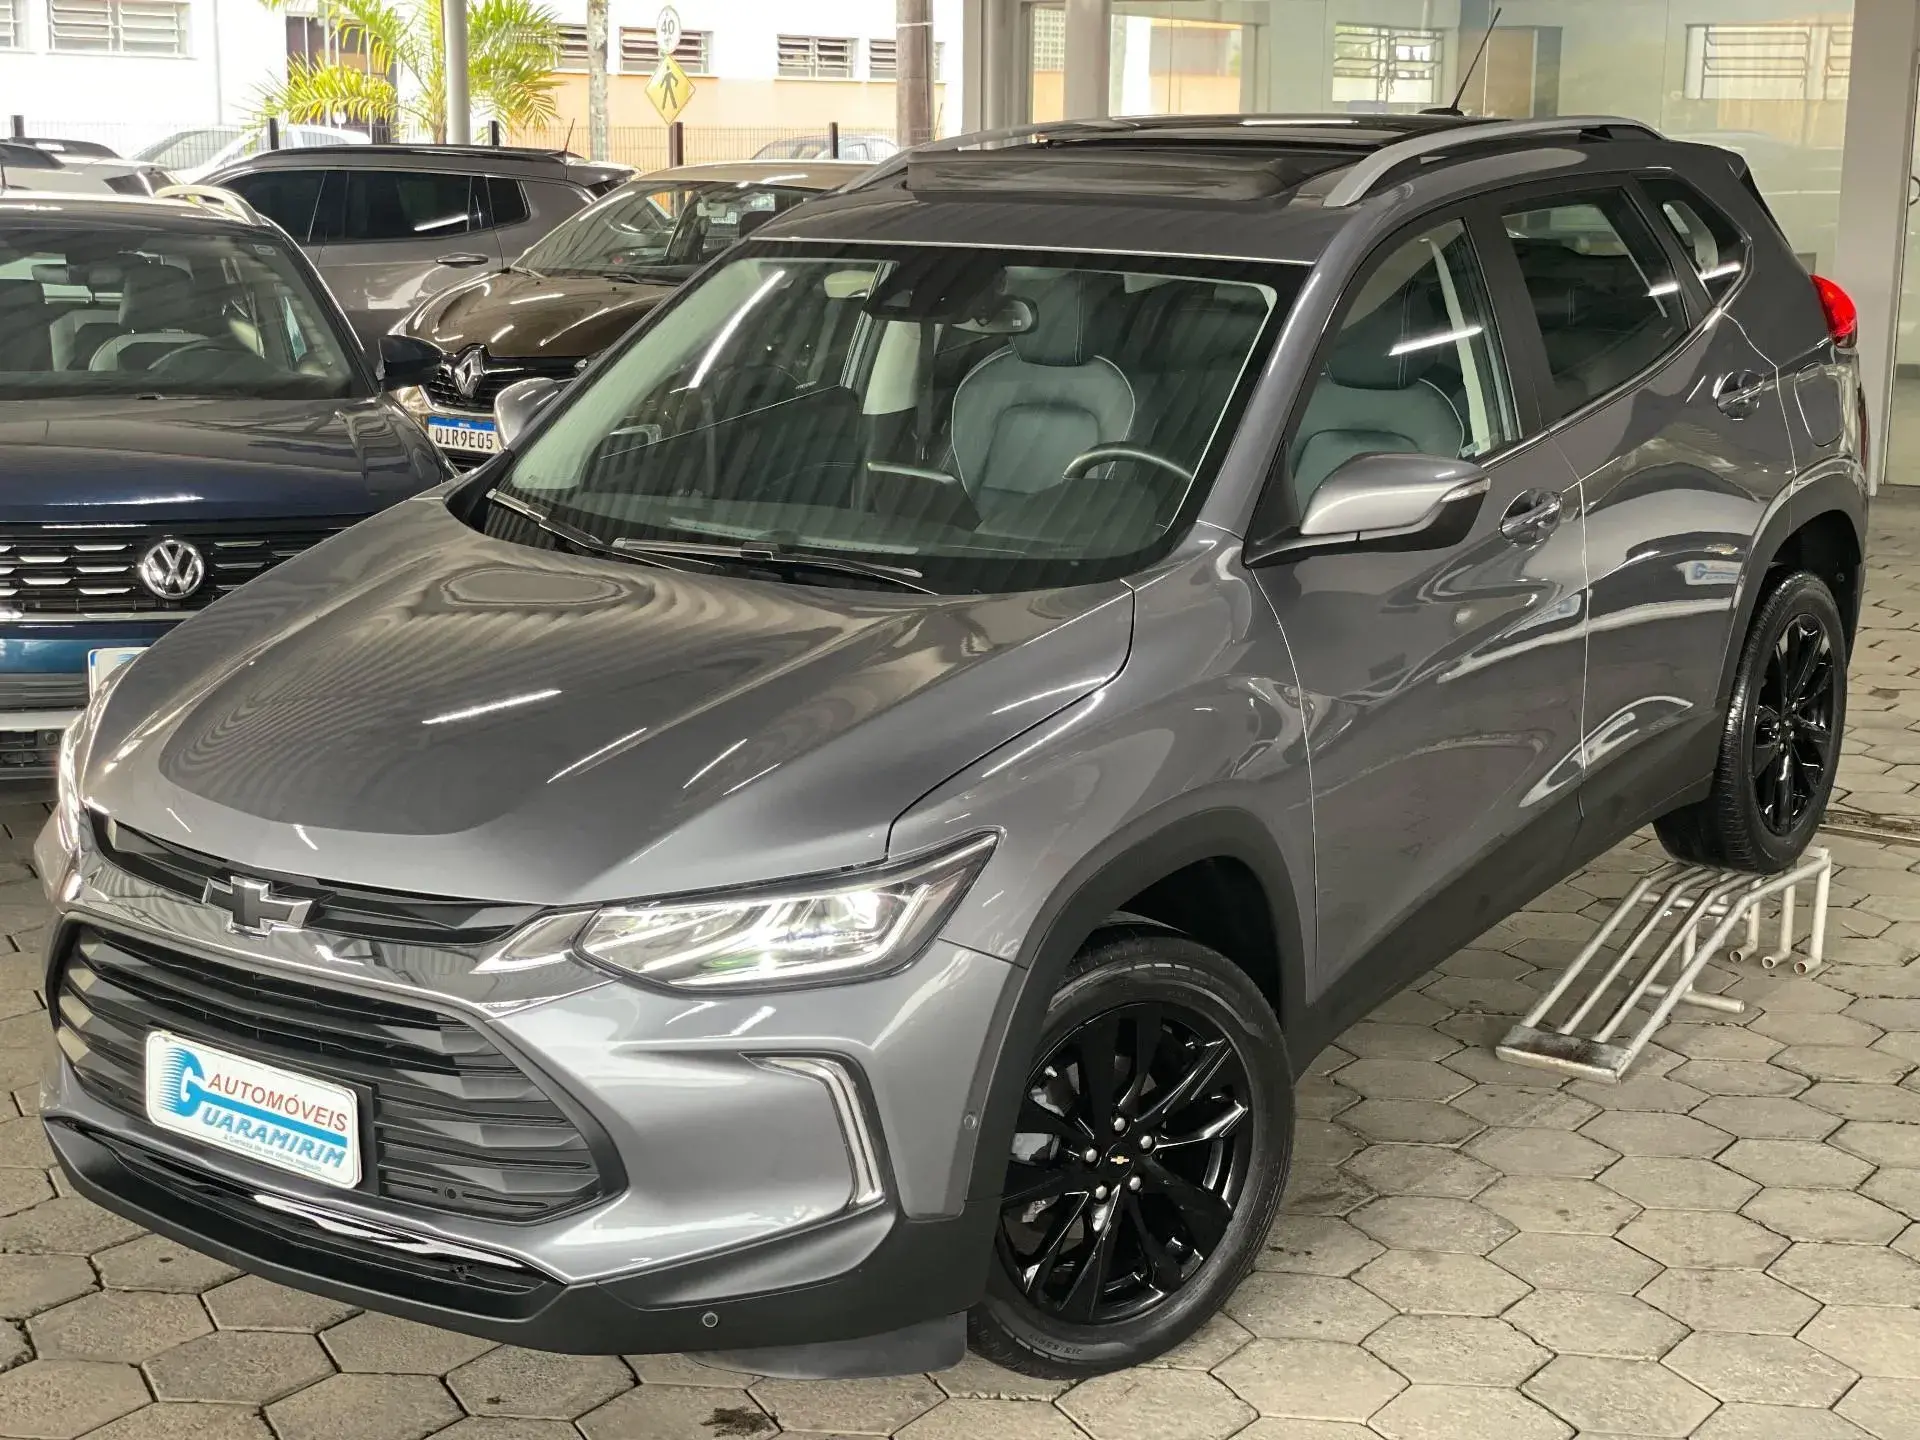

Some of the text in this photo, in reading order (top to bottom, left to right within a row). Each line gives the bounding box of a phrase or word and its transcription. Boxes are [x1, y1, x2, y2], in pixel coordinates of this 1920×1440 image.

[661, 19, 675, 35] 40
[435, 427, 493, 449] QIR9E05
[207, 1073, 348, 1132] AUTOMÓVEIS
